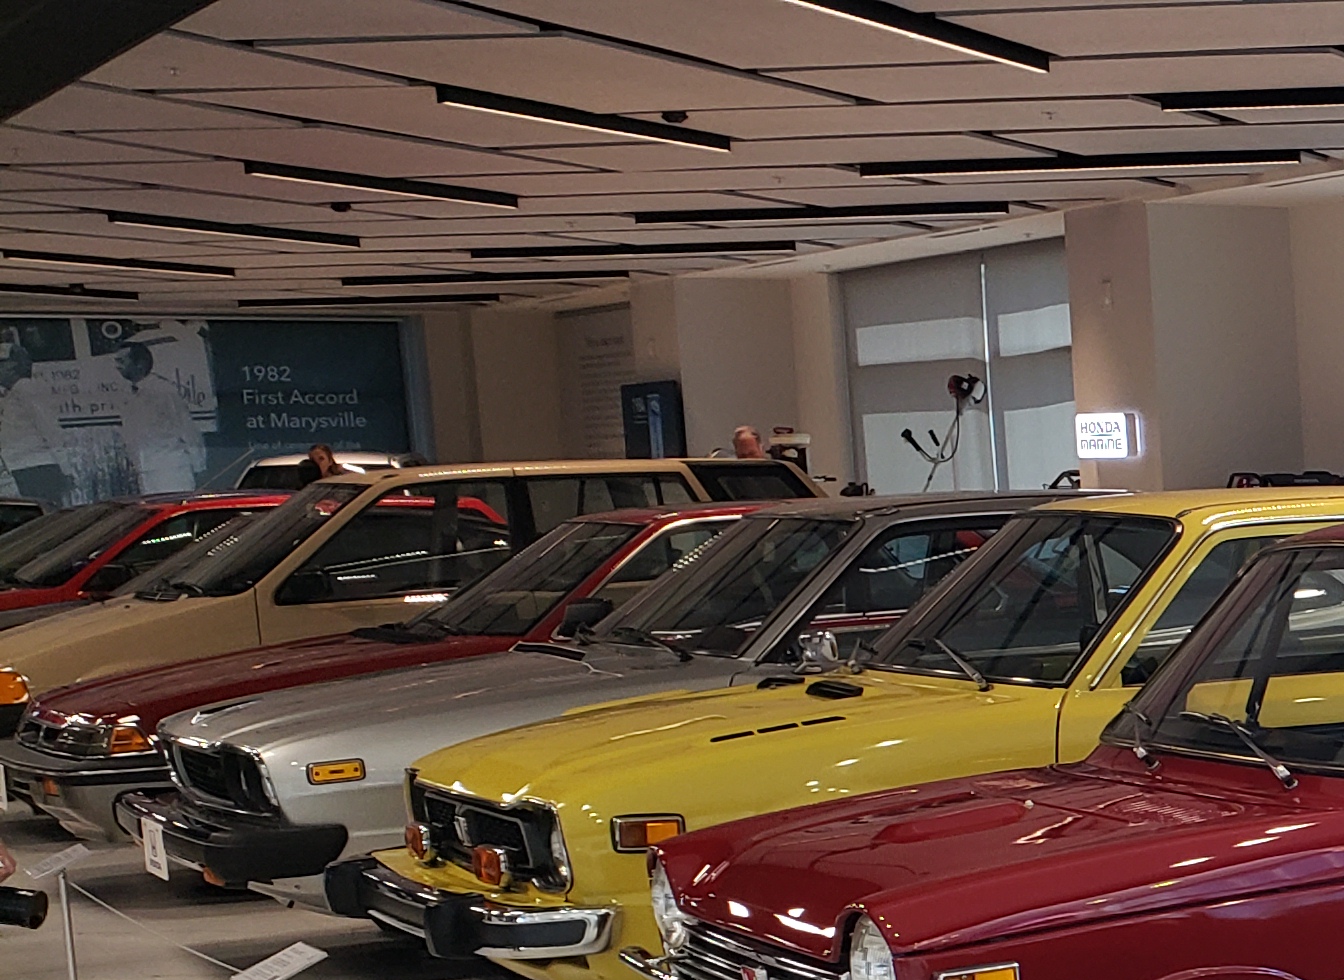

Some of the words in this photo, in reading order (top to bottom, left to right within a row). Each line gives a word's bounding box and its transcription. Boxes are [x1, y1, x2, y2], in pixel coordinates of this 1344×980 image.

[242, 365, 291, 382] 1982
[242, 389, 285, 405] First
[289, 387, 359, 405] Accord
[246, 415, 266, 429] at
[270, 411, 368, 433] Marysville
[1080, 421, 1121, 434] HONDA
[1080, 438, 1123, 450] MARINE
